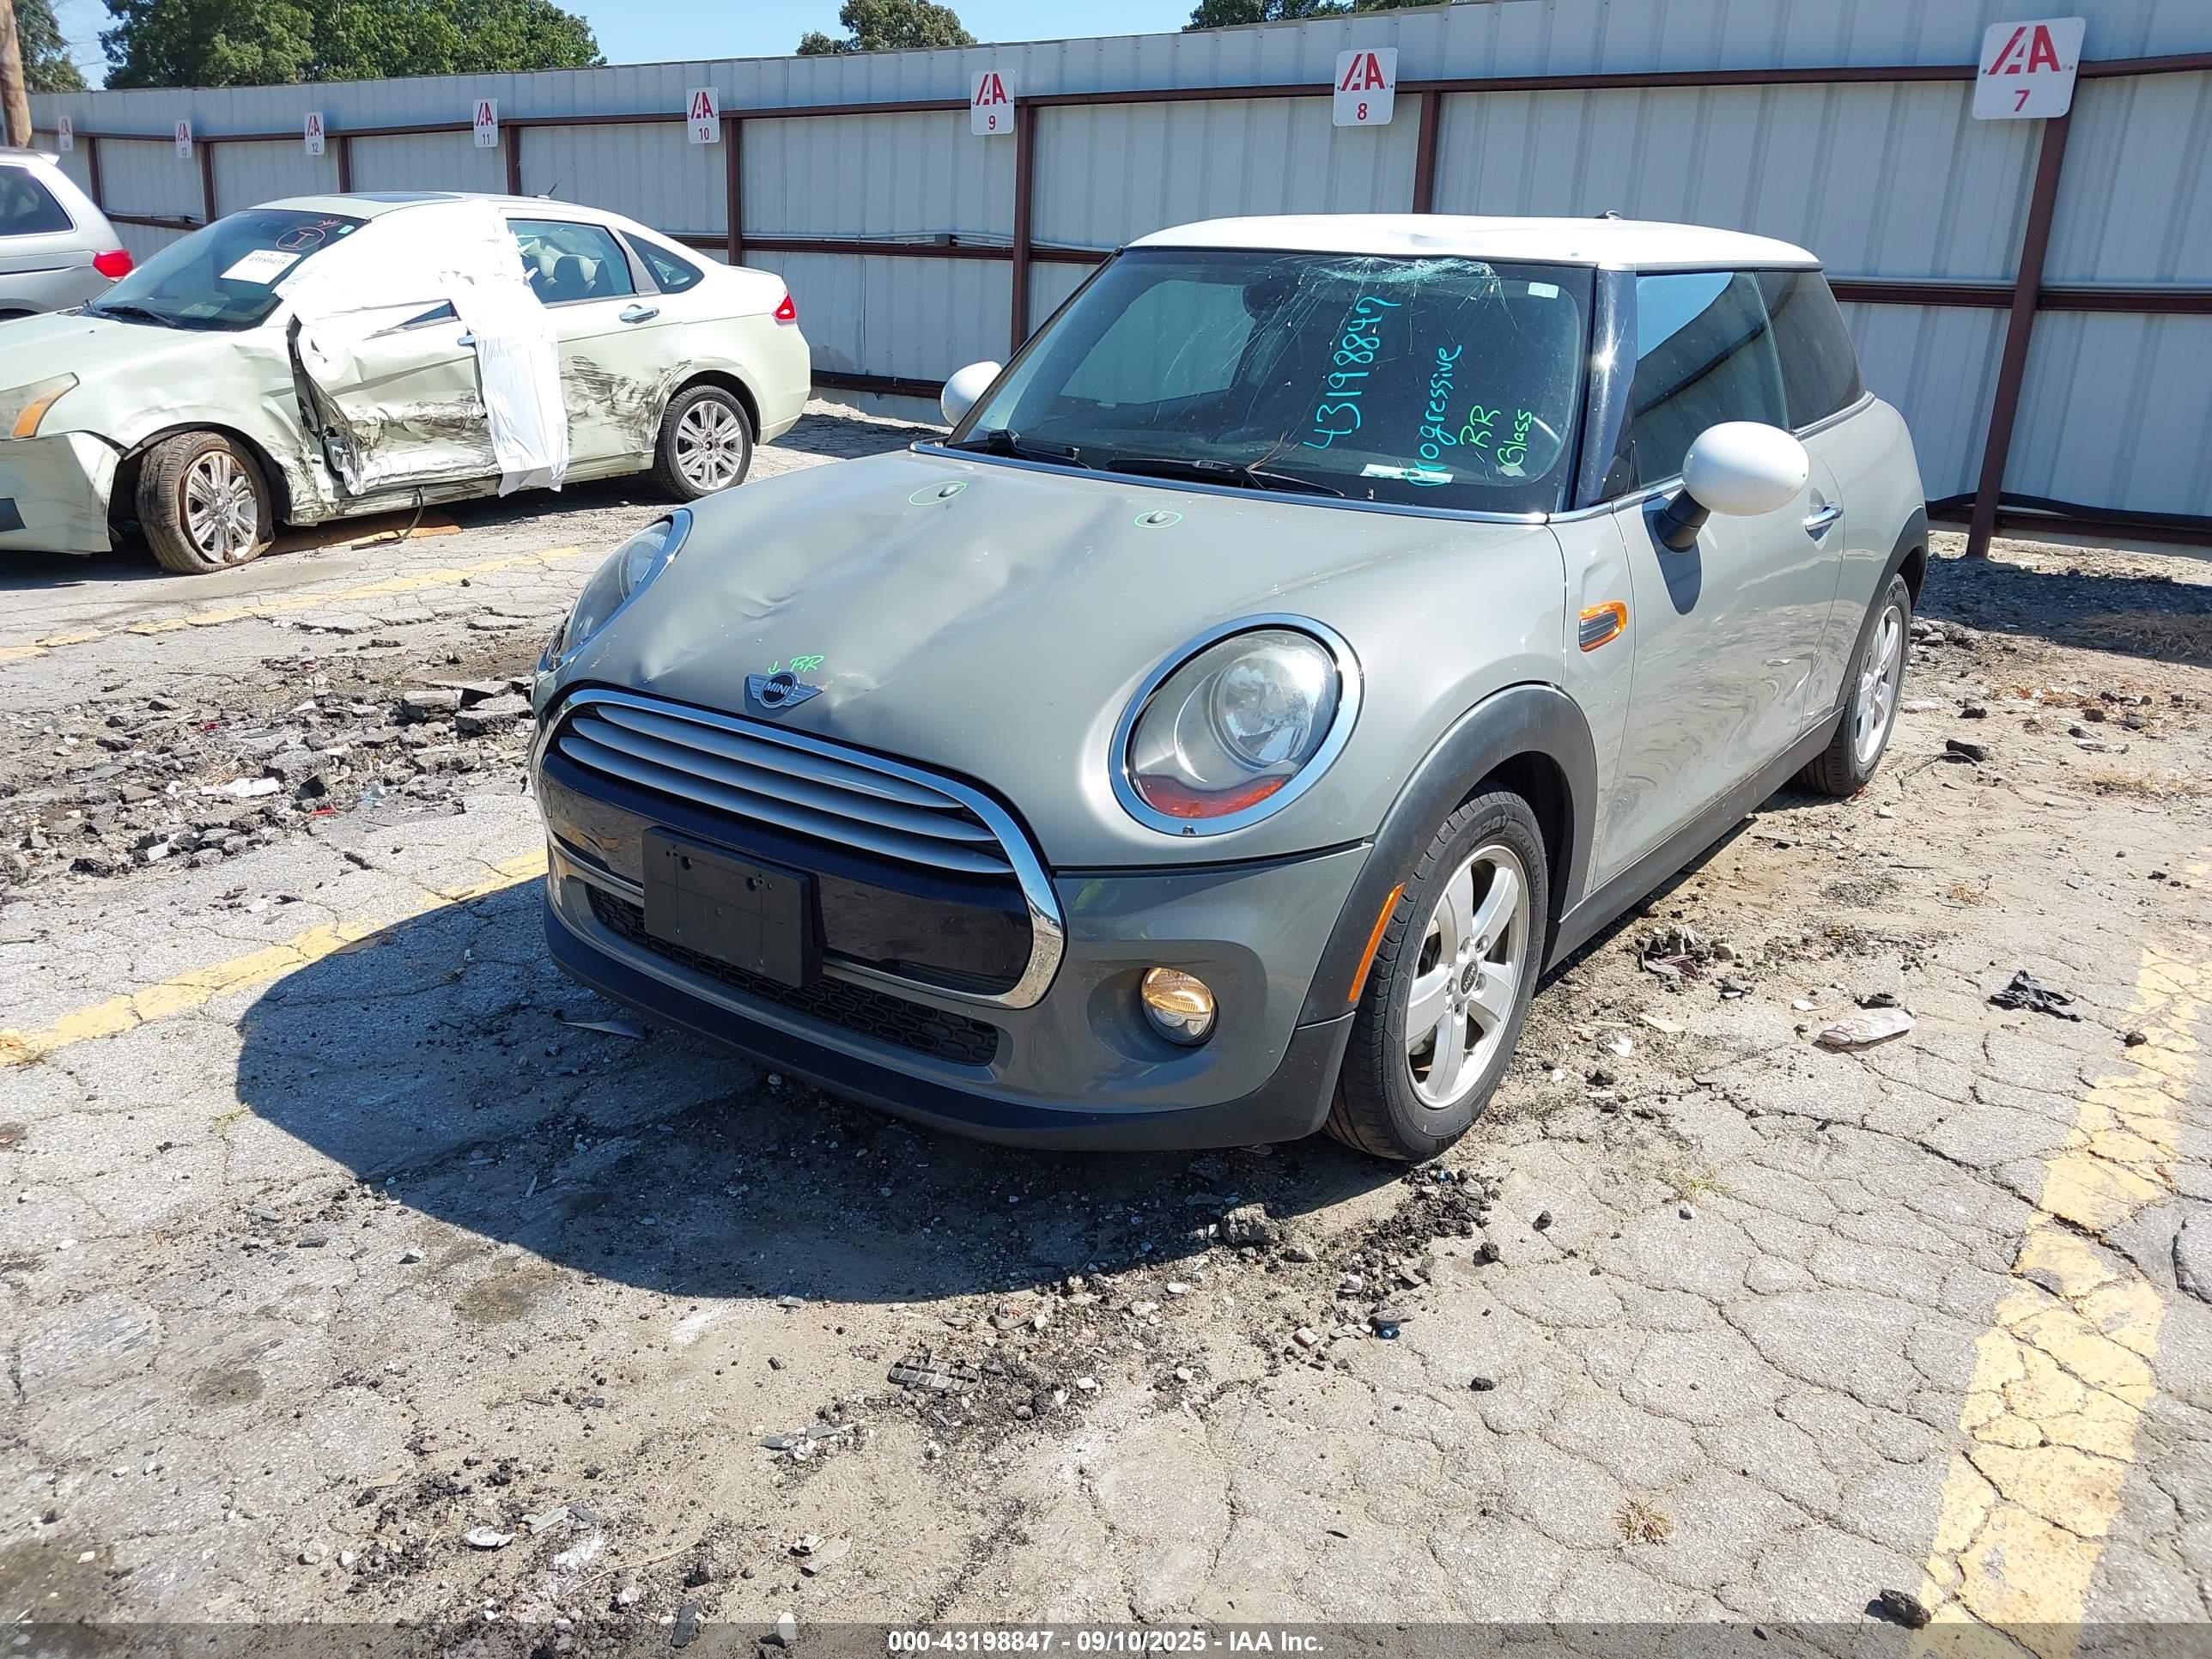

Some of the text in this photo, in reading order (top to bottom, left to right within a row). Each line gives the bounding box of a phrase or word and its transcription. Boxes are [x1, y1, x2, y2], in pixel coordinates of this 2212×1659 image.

[2014, 89, 2031, 112] 7
[1357, 102, 1368, 120] 8
[988, 115, 996, 131] 9
[483, 133, 490, 145] 11
[699, 127, 709, 141] 10
[312, 143, 319, 153] 12
[1303, 296, 1402, 449] 43198847
[1460, 405, 1501, 448] RR
[1497, 409, 1535, 468] Glass
[763, 681, 792, 696] MINI
[1462, 964, 1476, 990] MINI
